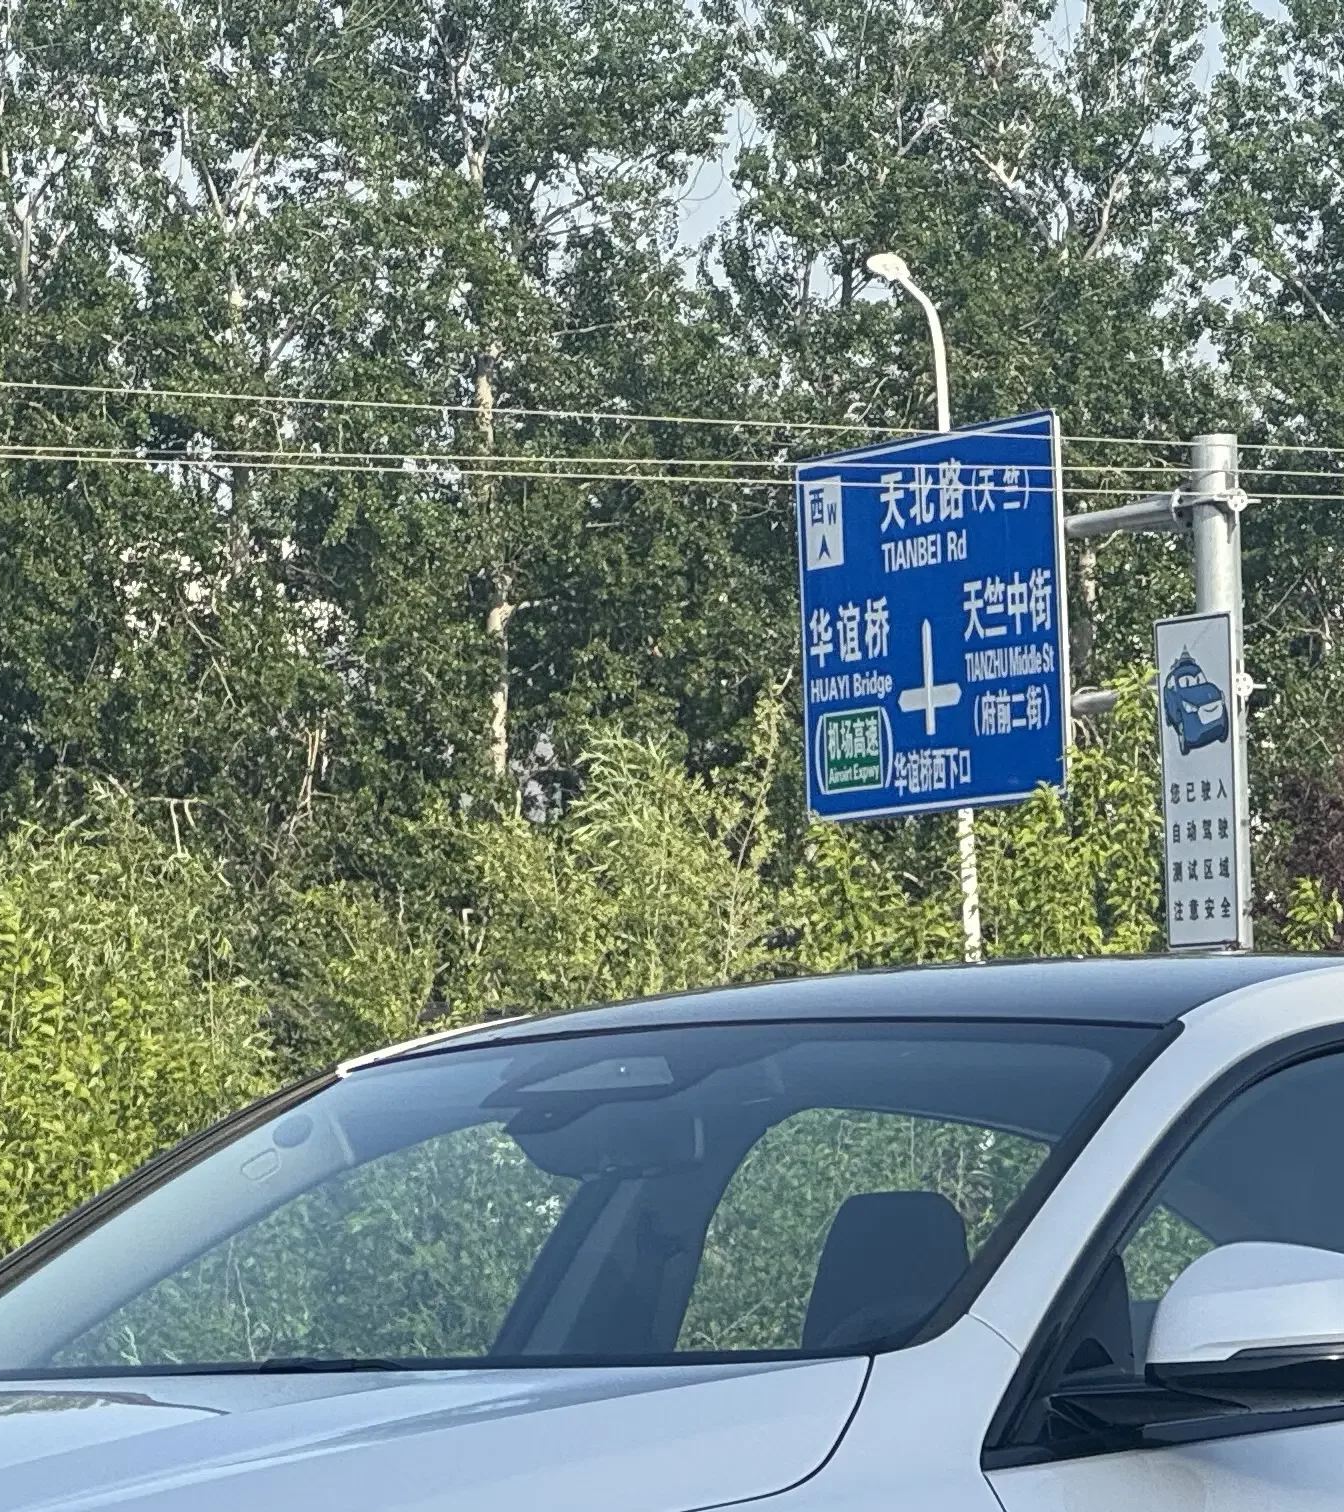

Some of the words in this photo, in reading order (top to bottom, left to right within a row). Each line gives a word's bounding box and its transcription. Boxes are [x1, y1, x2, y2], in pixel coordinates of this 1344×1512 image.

[809, 487, 825, 527] 西
[827, 502, 837, 526] W
[881, 533, 942, 574] TIANBEI
[946, 528, 968, 562] Rd
[963, 567, 1052, 642] 天竺中街
[809, 595, 890, 668] 华谊桥
[964, 647, 1008, 683] TIANZHU
[1009, 643, 1042, 677] Middle
[1042, 642, 1055, 673] St
[810, 674, 851, 704] HUAYI
[852, 669, 893, 700] Bridge
[827, 716, 879, 761] 机场高速
[894, 747, 972, 797] 华谊桥西下口
[1169, 778, 1228, 805] 您已驶入
[1172, 816, 1229, 844] 自动驾驶
[1172, 856, 1230, 883] 测试区域
[1173, 896, 1231, 922] 注意安全
